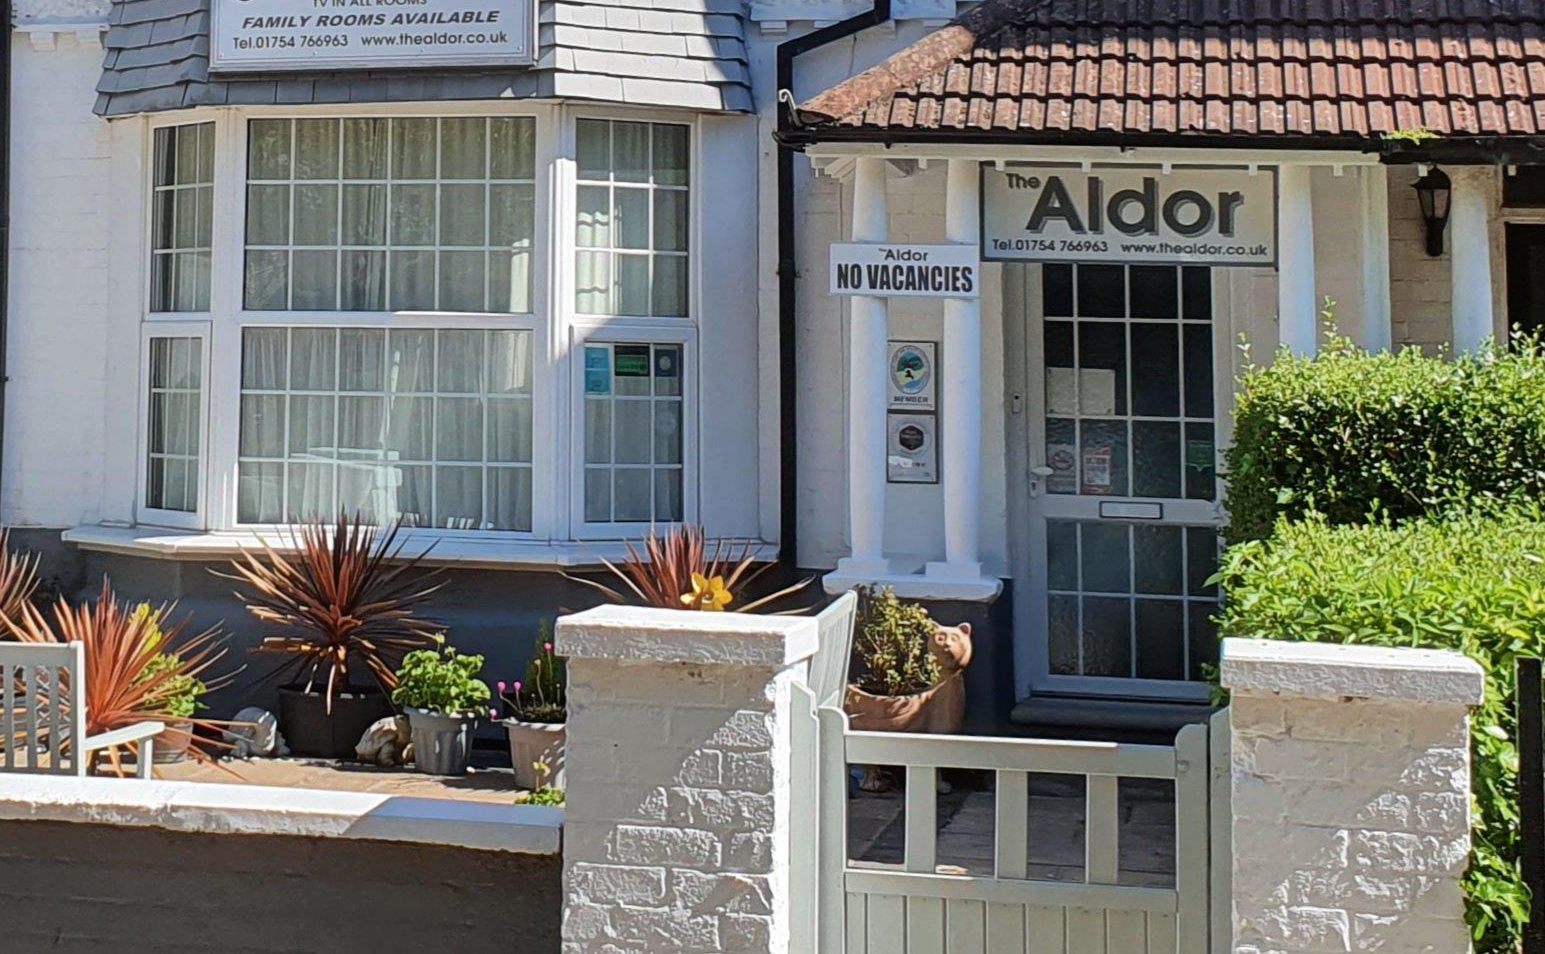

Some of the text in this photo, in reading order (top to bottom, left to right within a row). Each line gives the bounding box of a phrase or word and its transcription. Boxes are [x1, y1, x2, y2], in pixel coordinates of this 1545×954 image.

[242, 10, 501, 29] FAMILY ROOMS AVAILABLE
[233, 30, 508, 50] Tel.01754 766963 www.thealdor.co.uk
[1006, 173, 1244, 238] The Aldor
[884, 249, 929, 262] Aldor
[992, 239, 1267, 256] Tel.01754 766963 www.thealdor.co.uk
[837, 263, 973, 293] NO VACANCIES
